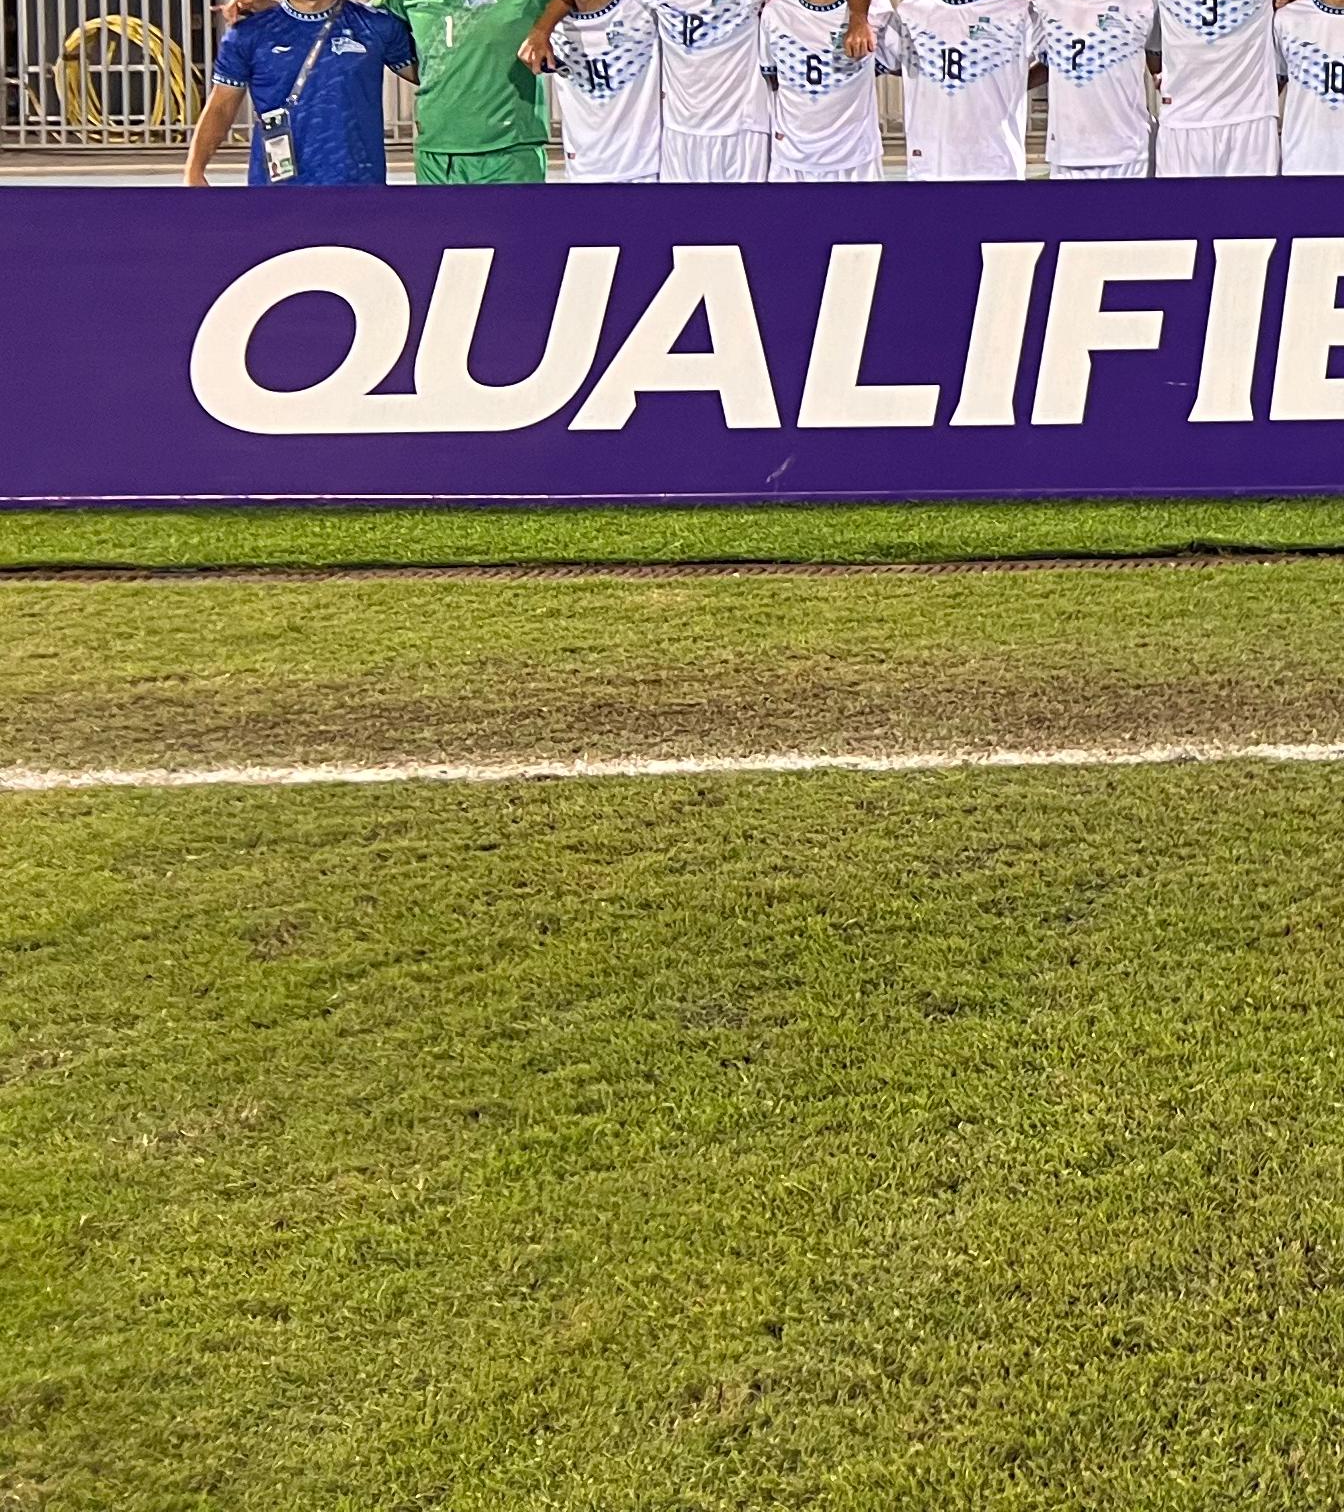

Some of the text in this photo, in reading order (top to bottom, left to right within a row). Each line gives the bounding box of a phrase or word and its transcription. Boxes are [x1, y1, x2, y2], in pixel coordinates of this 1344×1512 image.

[446, 15, 453, 48] 1
[585, 59, 613, 91] 14
[806, 54, 822, 85] 6
[940, 48, 963, 81] 18
